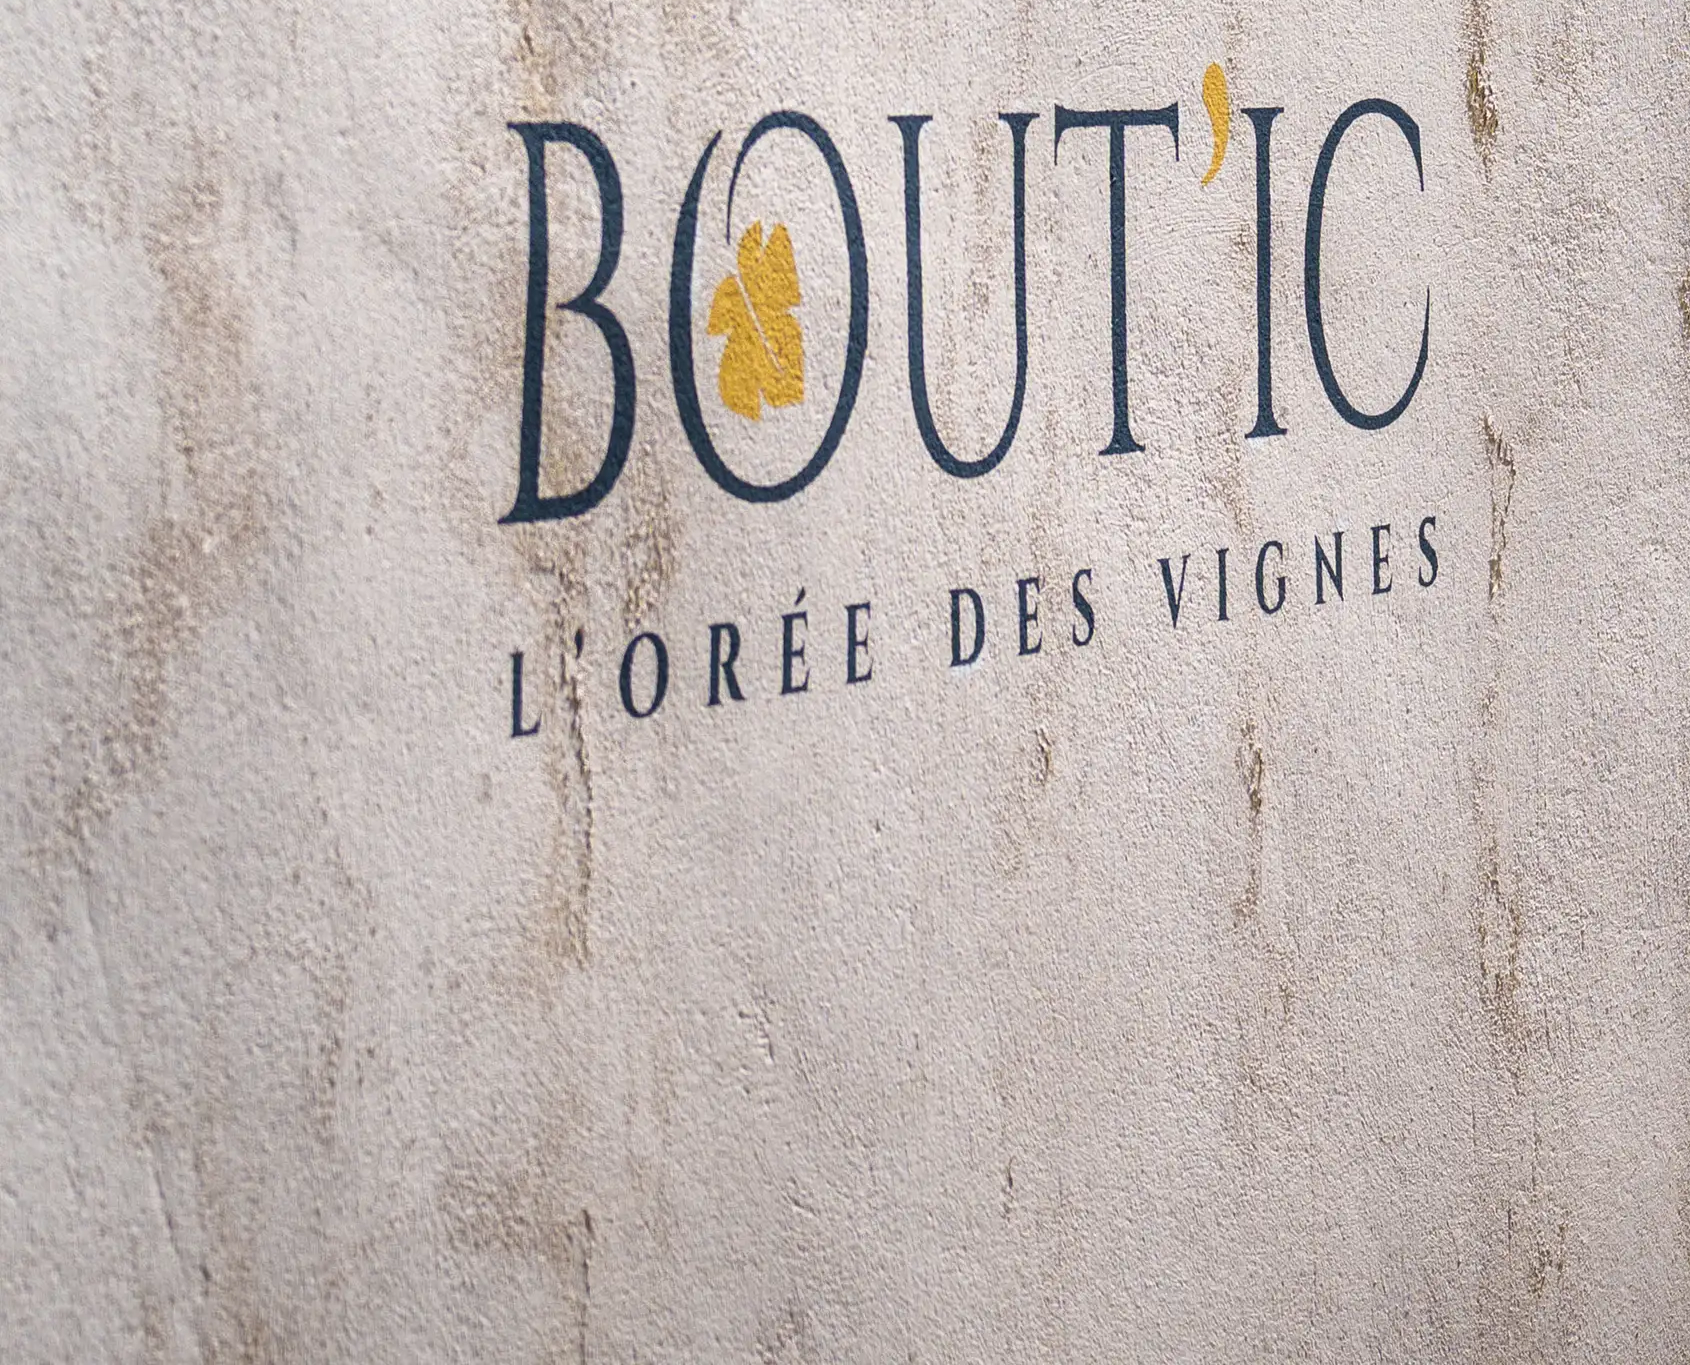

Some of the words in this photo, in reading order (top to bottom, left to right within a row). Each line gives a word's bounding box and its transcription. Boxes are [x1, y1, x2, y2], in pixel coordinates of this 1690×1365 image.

[496, 61, 1432, 525] BOUT'IC
[509, 587, 875, 739] L'ORÉE
[949, 569, 1096, 668] DES
[1156, 515, 1441, 630] VIGNES
